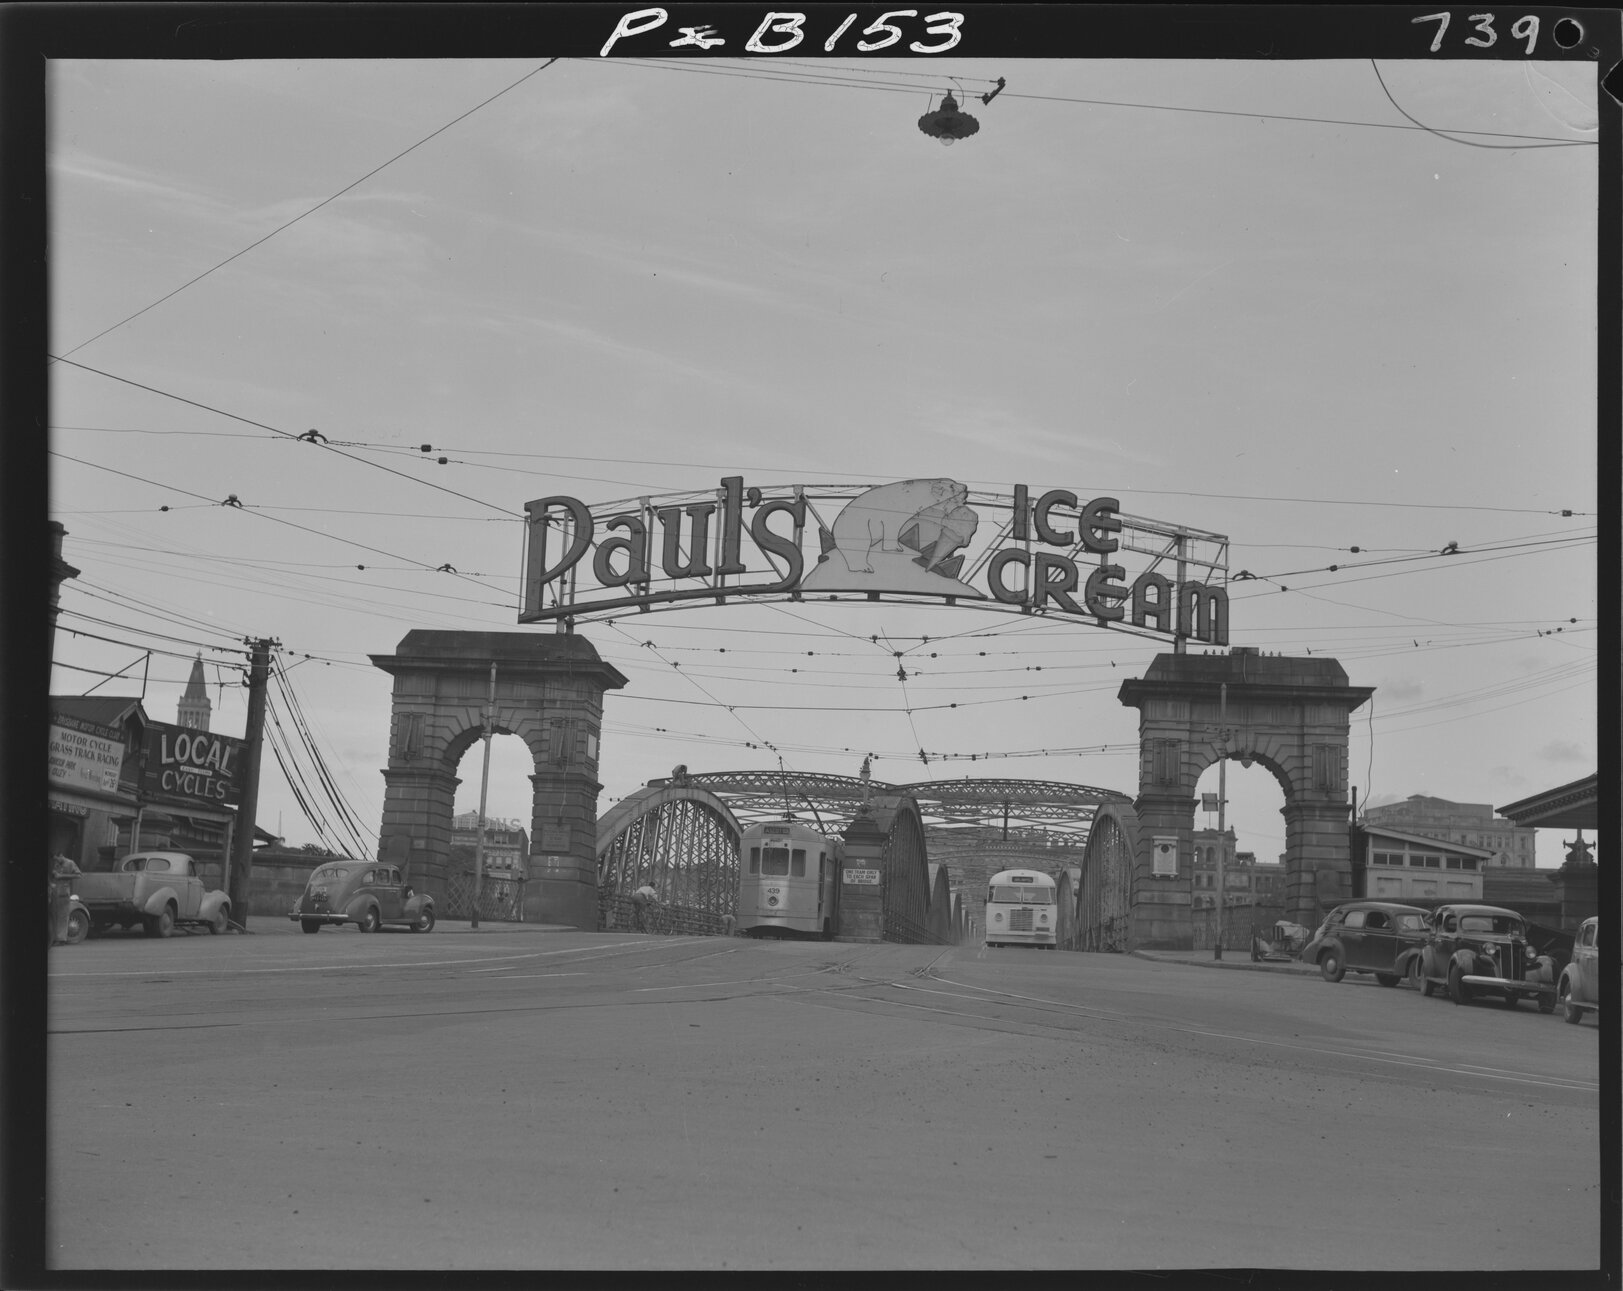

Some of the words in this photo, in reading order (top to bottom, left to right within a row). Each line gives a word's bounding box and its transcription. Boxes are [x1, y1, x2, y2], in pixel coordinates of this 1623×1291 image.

[1013, 484, 1122, 553] ICE
[518, 475, 806, 624] Paul's
[988, 548, 1229, 646] CREAM
[49, 741, 73, 756] GRASS
[74, 747, 95, 761] TRACK
[97, 752, 120, 767] RACING
[61, 731, 87, 747] MOTOR
[89, 739, 112, 753] CYCLE
[161, 733, 233, 778] LOCAL
[162, 769, 226, 799] CYCLES
[767, 887, 780, 895] 439
